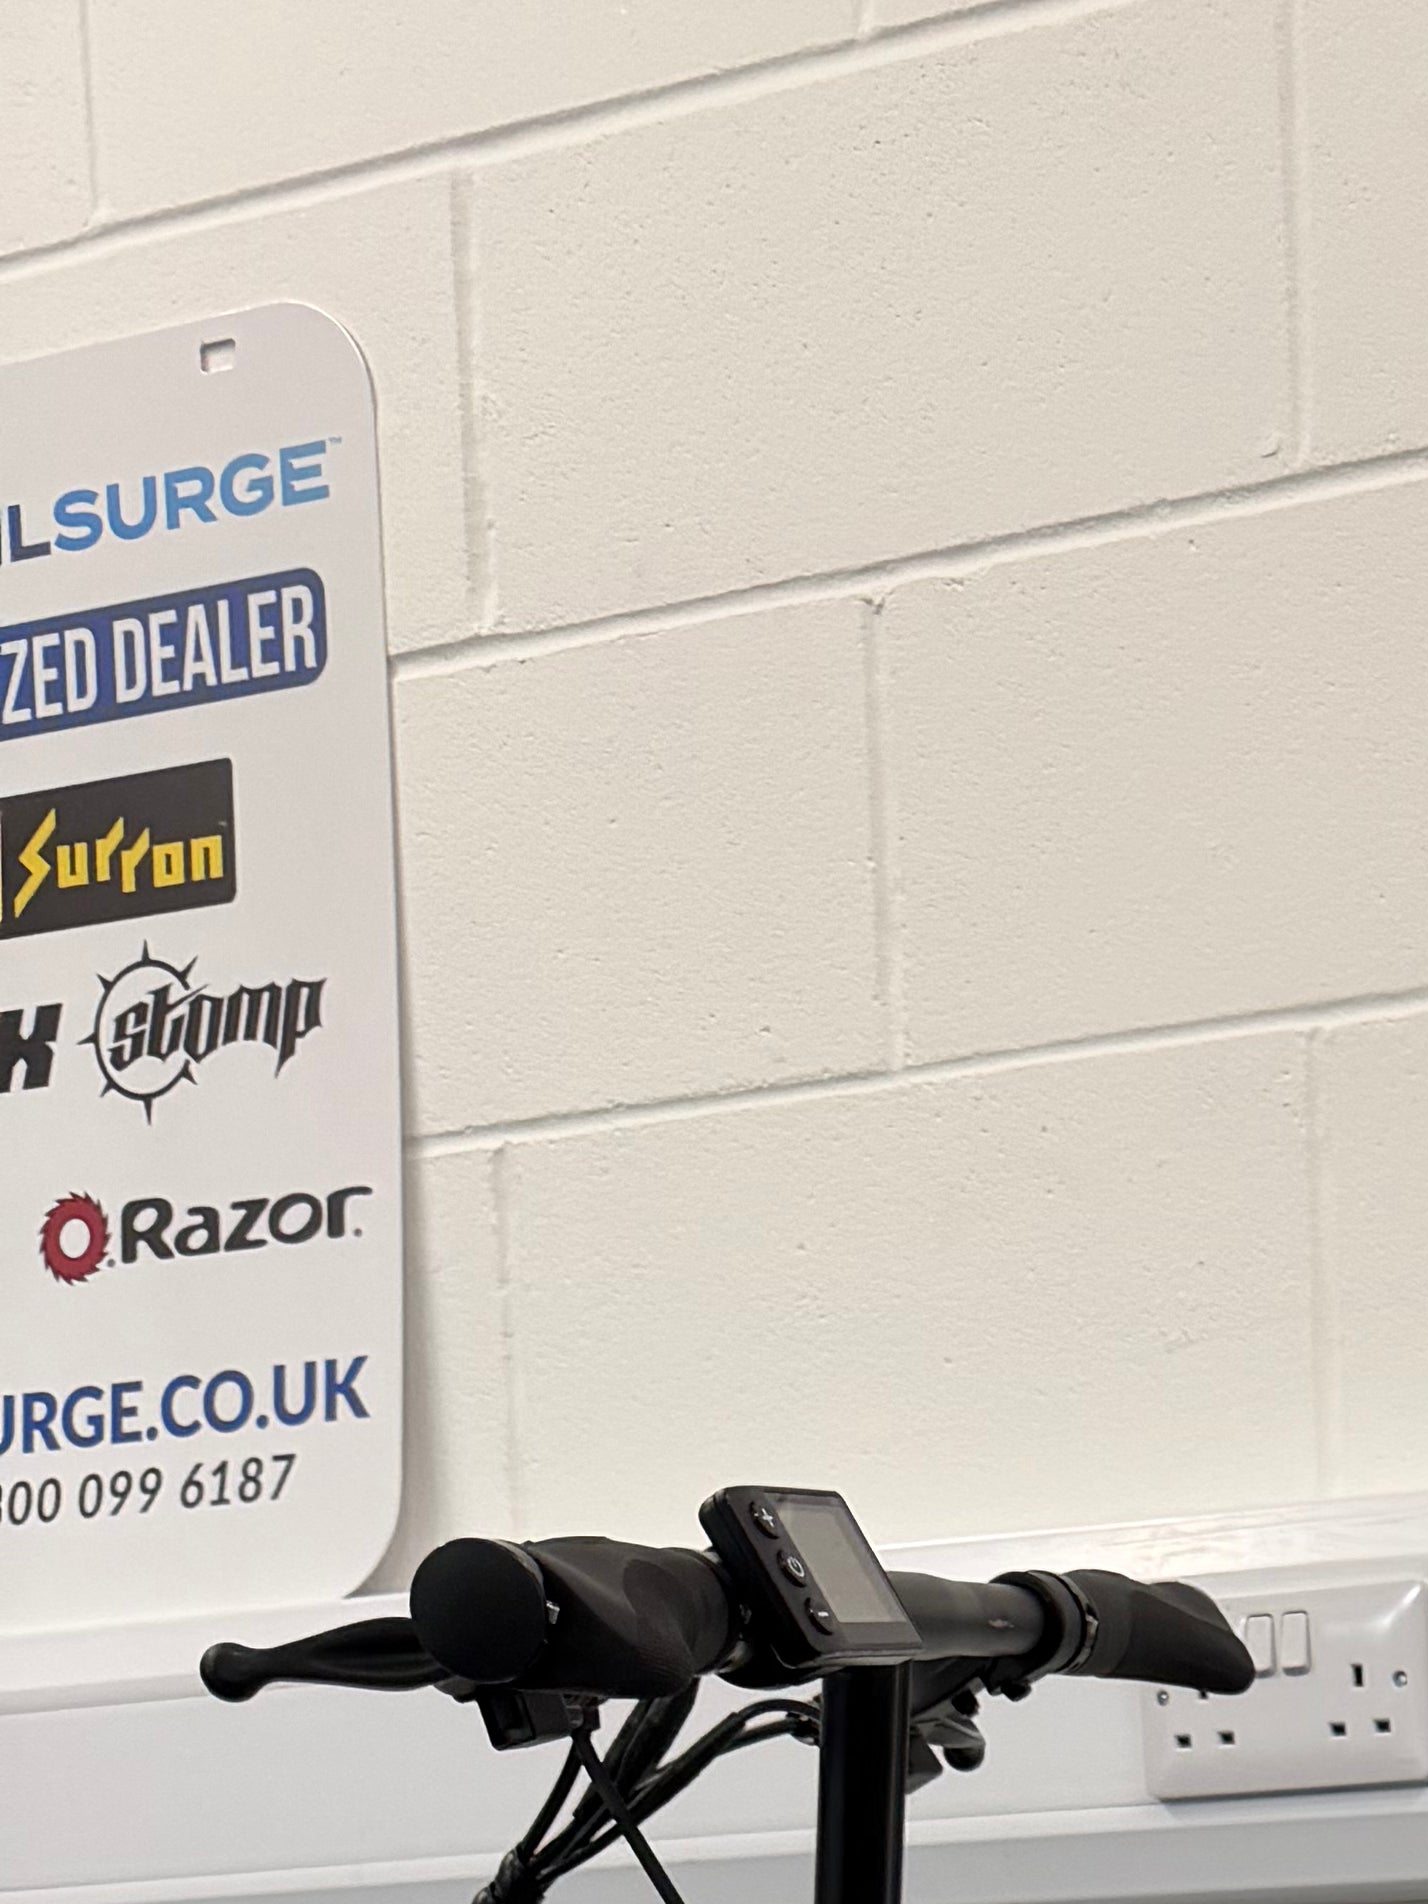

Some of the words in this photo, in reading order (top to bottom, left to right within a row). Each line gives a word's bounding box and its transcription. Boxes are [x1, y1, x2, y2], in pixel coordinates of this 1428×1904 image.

[0, 440, 330, 564] LSURGE
[0, 628, 98, 725] ZED
[113, 585, 317, 703] DEALER
[120, 1186, 373, 1263] Razor
[0, 1475, 61, 1526] 00
[78, 1467, 162, 1518] 099
[180, 1454, 296, 1508] 6187
